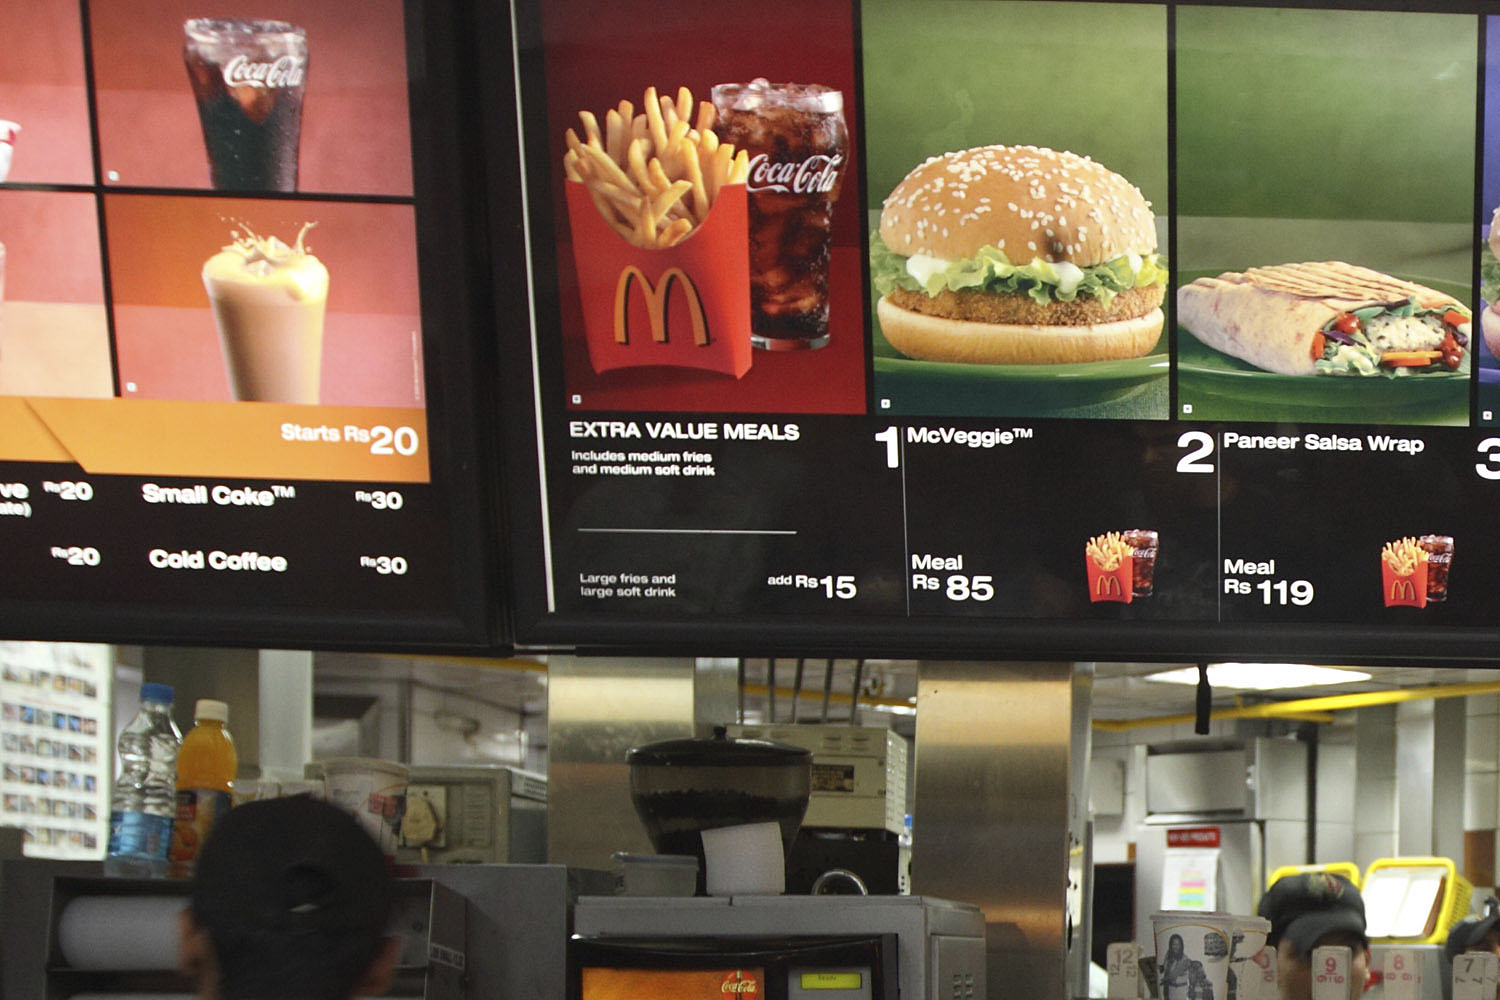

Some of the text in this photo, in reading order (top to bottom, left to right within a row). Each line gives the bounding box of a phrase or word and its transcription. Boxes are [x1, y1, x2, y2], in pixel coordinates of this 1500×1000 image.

[281, 423, 340, 441] Starts
[570, 422, 799, 440] EXTRA VALUE MEALS
[875, 426, 899, 469] 1
[1177, 431, 1424, 473] 2 Paneer Salsa Wrap
[571, 450, 713, 464] Includes medium fries
[572, 463, 715, 477] and medium soft drink
[142, 483, 208, 504] Small
[149, 549, 205, 569] Cold
[208, 551, 288, 572] Coffee
[912, 554, 962, 570] Meal
[1225, 559, 1274, 574] Meal
[579, 573, 676, 588] Large fries and
[767, 574, 793, 586] add
[912, 574, 995, 602] Rs 85
[580, 586, 676, 599] large soft drink
[1224, 579, 1315, 606] Rs 119
